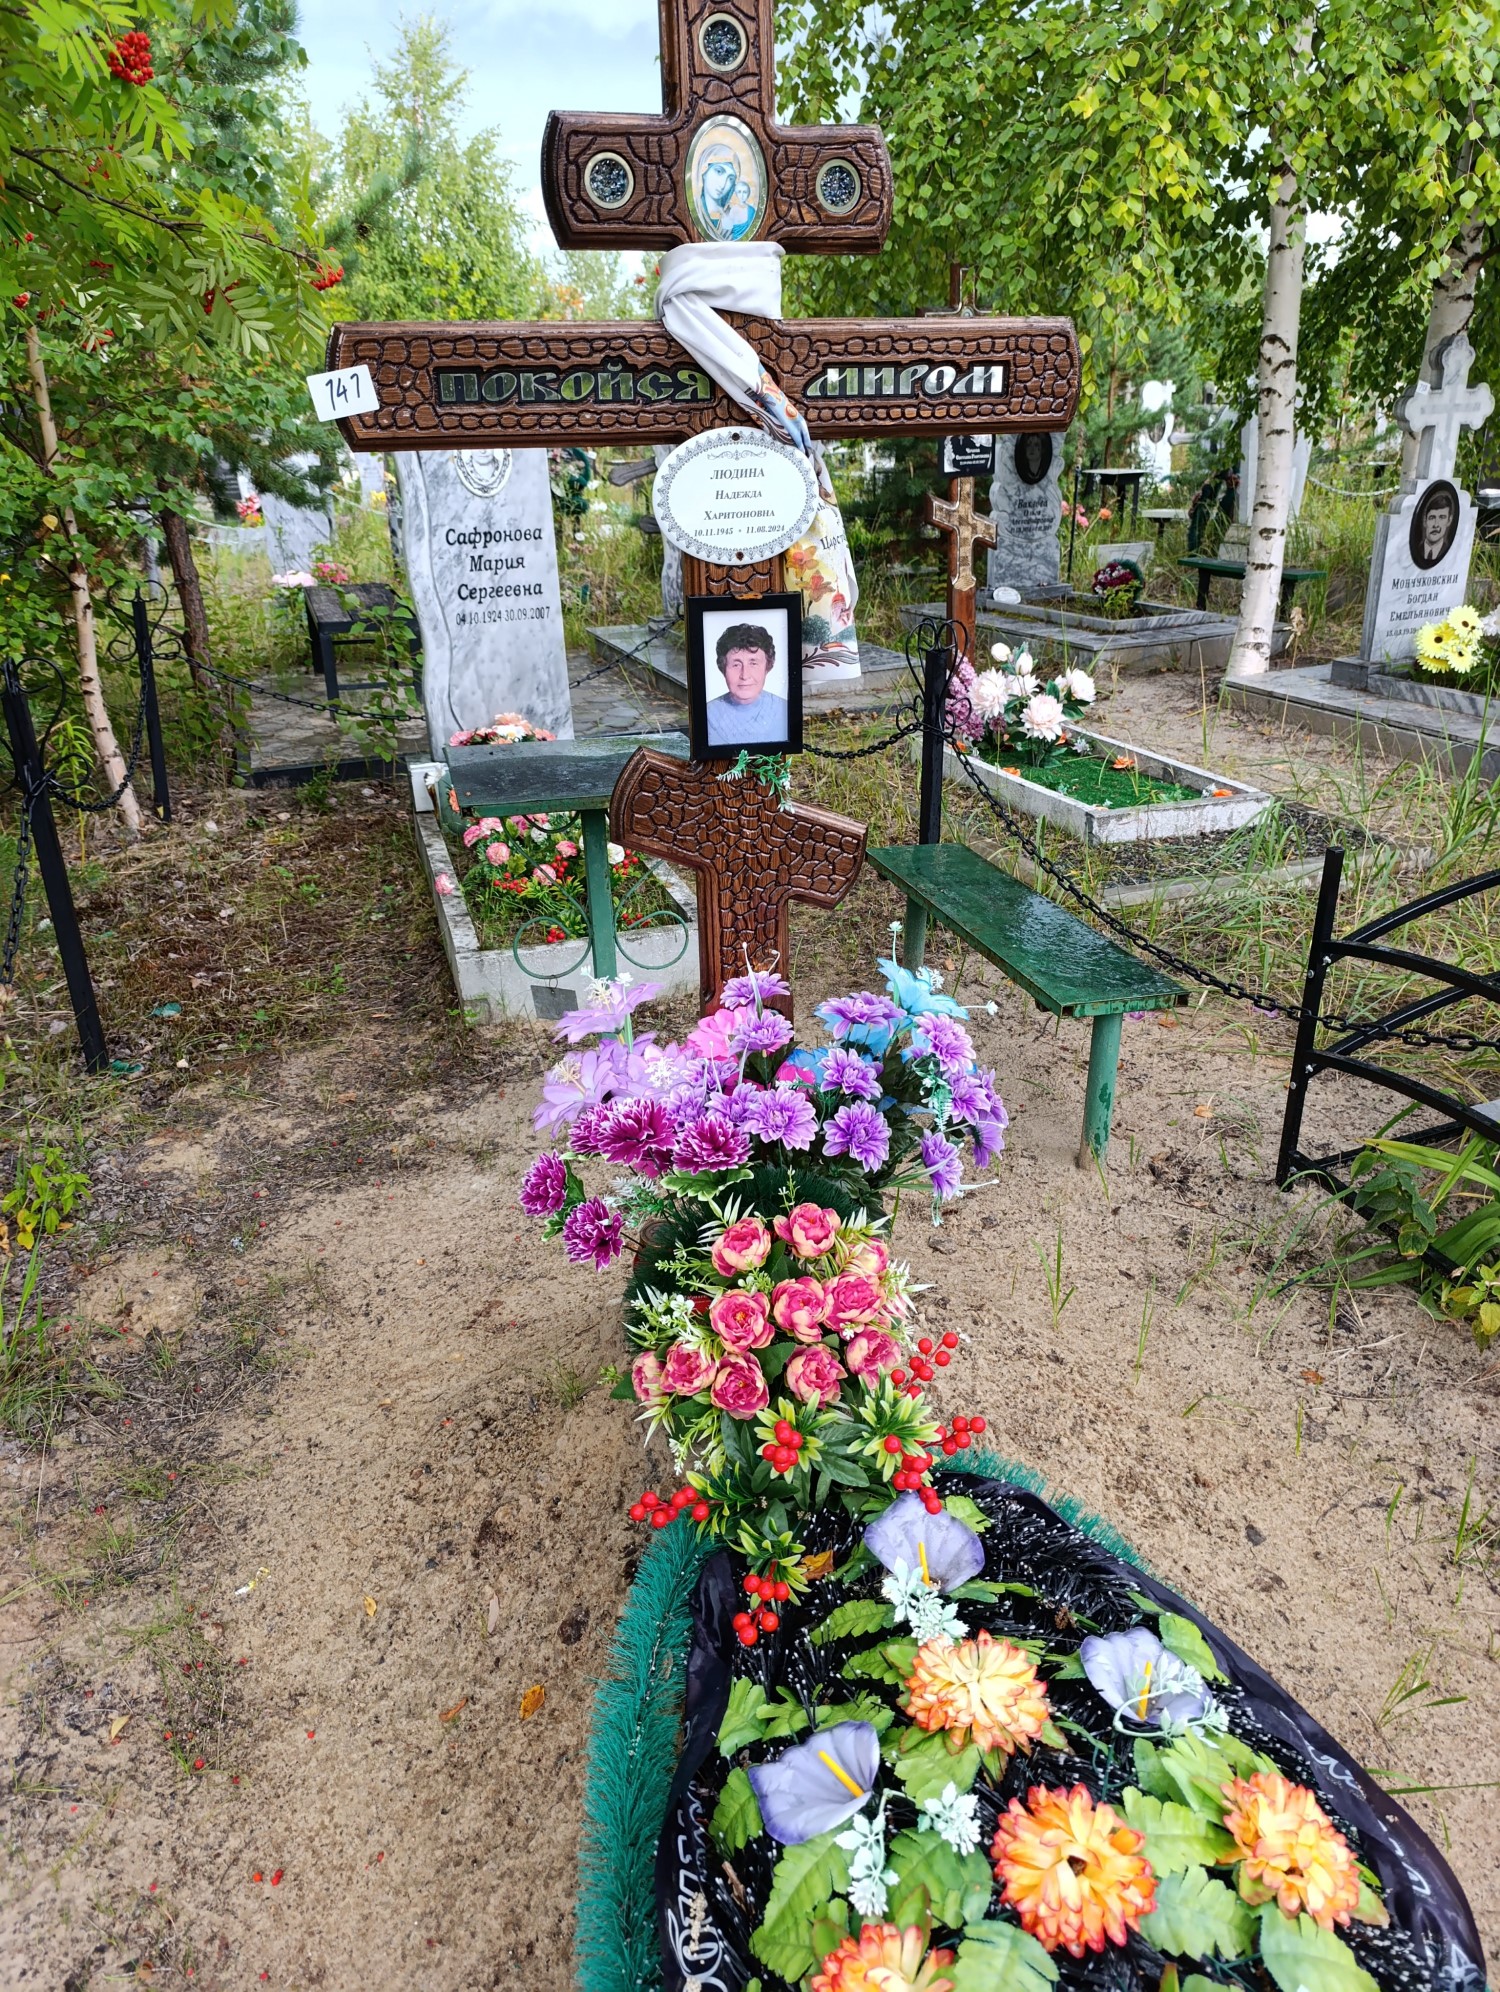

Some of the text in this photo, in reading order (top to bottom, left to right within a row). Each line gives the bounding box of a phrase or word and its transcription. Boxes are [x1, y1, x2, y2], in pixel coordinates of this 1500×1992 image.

[439, 361, 1004, 401] ПОКОЙСЯ МИРОМ
[710, 468, 765, 480] ЛЮДИНА
[445, 527, 543, 549] Сафронова
[694, 524, 785, 537] 10.11.1945 11.08.2024
[469, 555, 526, 575] Мария
[457, 583, 544, 604] Сергеевна
[1407, 593, 1439, 604] БОГДАН
[456, 606, 551, 626] 04.10.1924 30.09.2007
